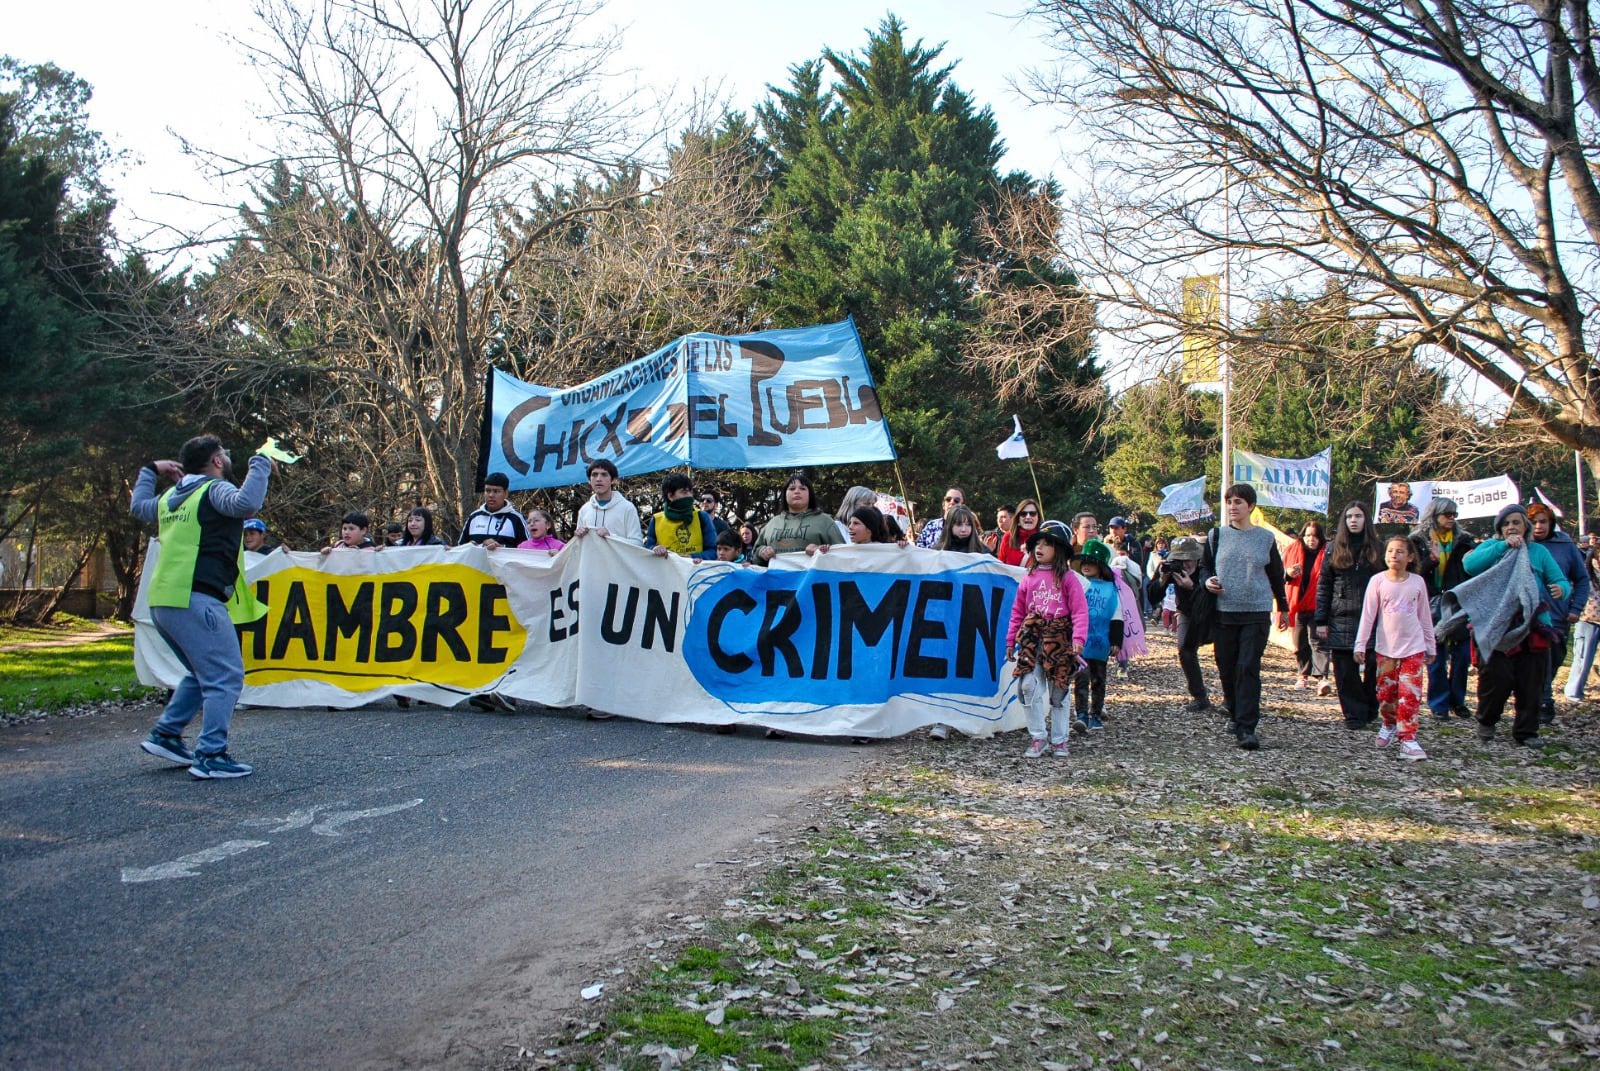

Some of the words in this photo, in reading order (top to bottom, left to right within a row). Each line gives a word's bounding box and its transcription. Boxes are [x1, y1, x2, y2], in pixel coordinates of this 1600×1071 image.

[683, 341, 699, 373] DE
[705, 339, 733, 372] LXS
[1235, 464, 1257, 482] EL
[1468, 489, 1508, 505] Cajade
[1039, 579, 1047, 590] A
[233, 580, 511, 665] HAMBRE
[550, 579, 579, 643] ES
[601, 582, 680, 653] UN
[707, 579, 1005, 683] CRIMEN
